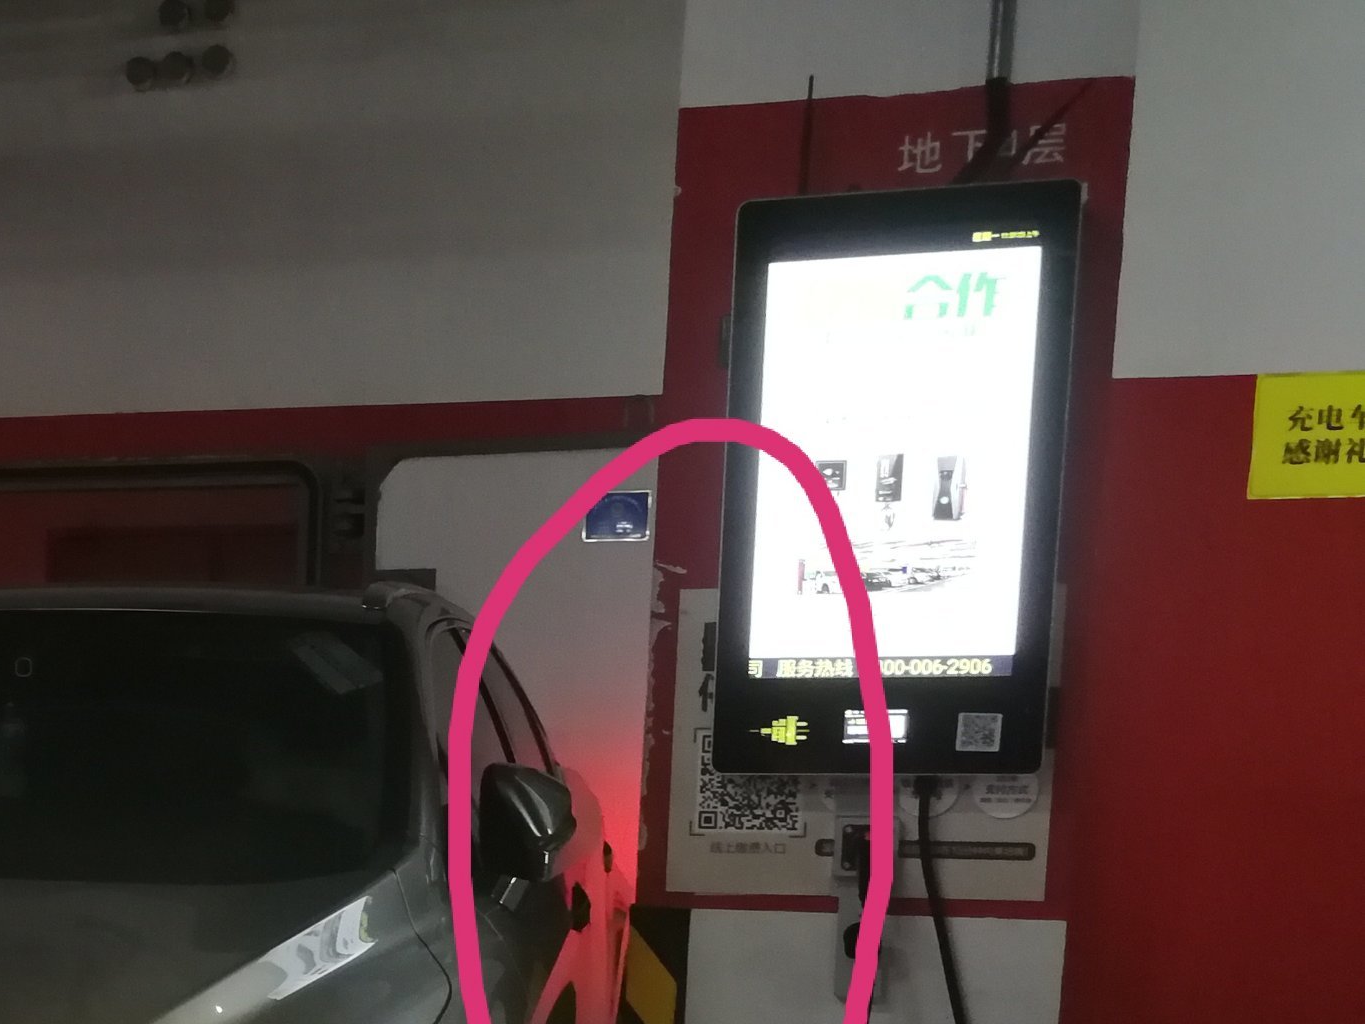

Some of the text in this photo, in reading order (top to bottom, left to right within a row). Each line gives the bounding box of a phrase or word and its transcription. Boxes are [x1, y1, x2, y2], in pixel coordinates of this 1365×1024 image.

[776, 659, 854, 678] 服务热线
[879, 658, 993, 676] 00-006-2906
